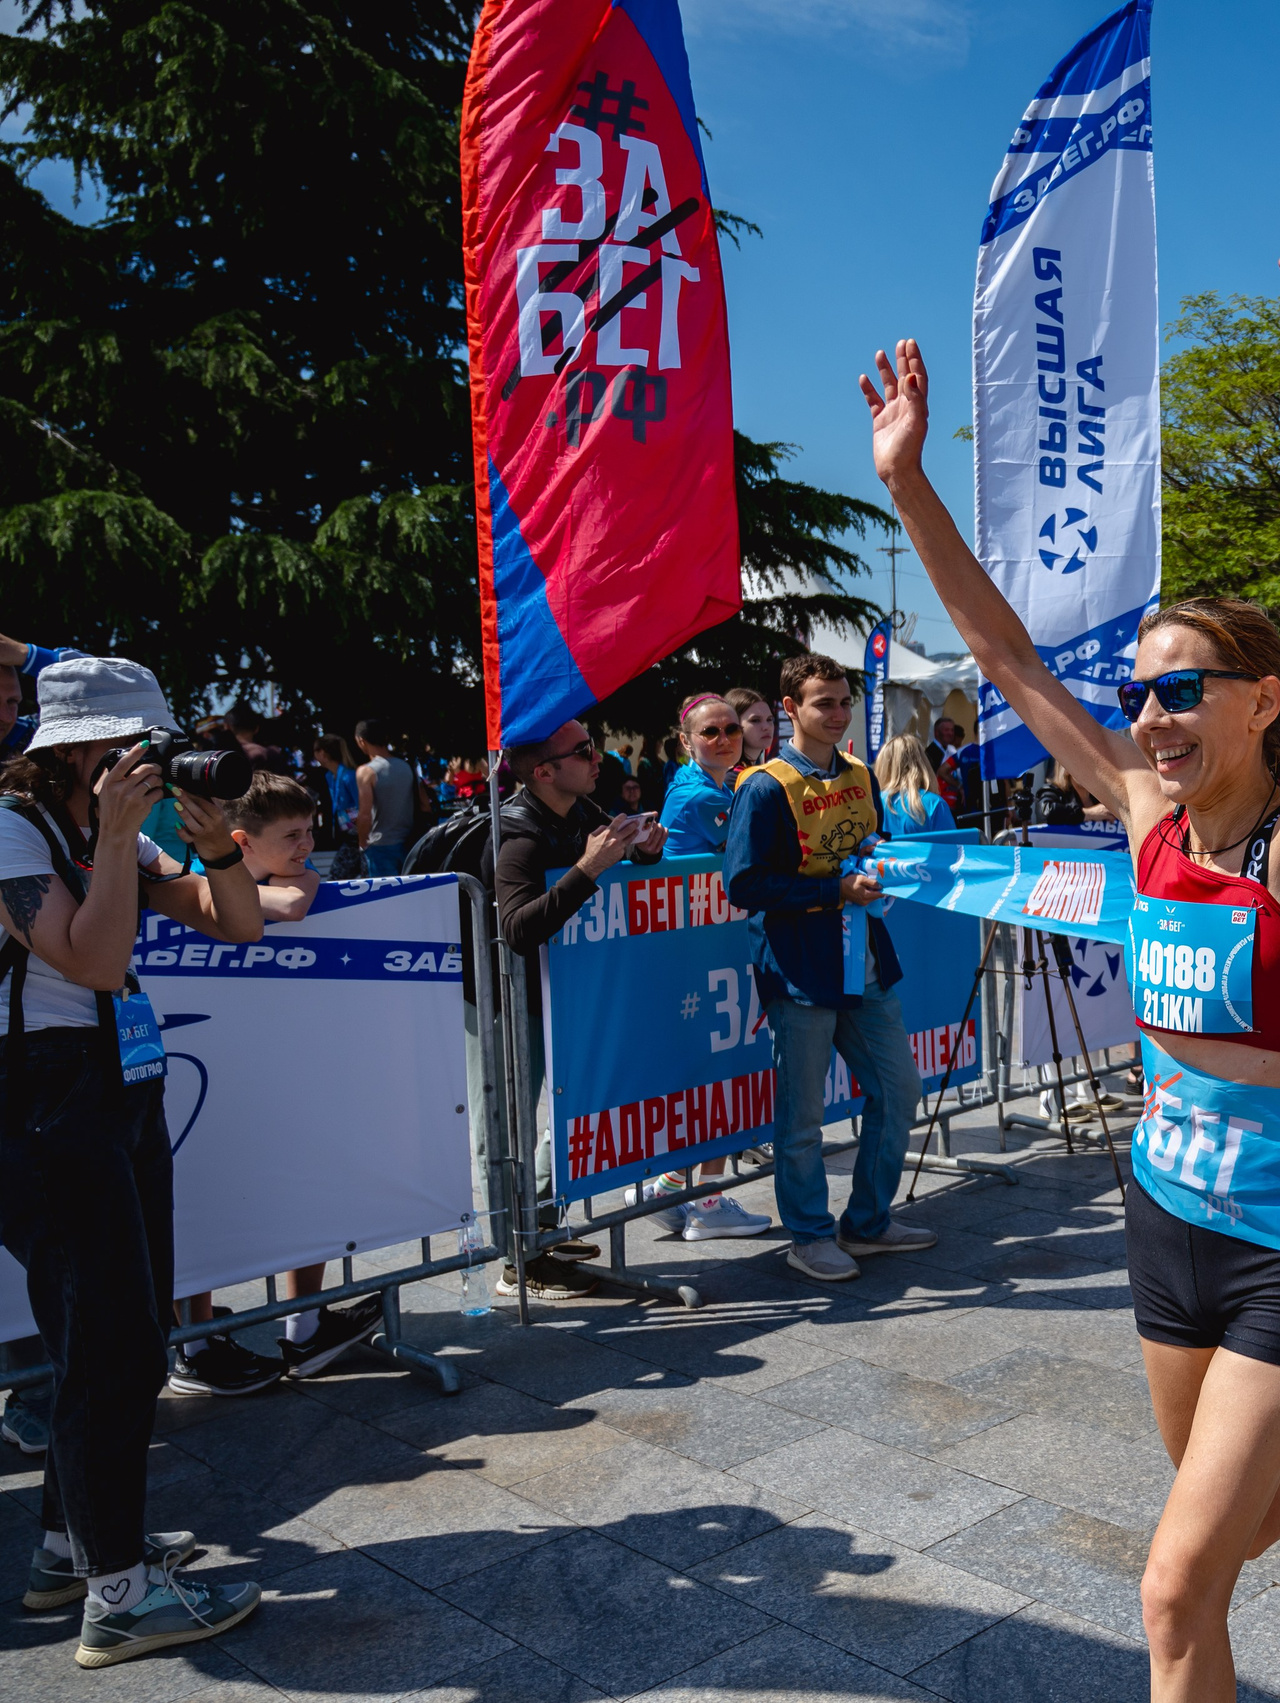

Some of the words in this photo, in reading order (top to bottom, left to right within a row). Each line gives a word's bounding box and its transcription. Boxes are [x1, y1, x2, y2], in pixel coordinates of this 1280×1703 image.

[543, 122, 680, 257] ЗА
[516, 242, 700, 377] БЕГ
[1032, 246, 1067, 489] ВЫСШАЯ
[1076, 355, 1106, 495] ЛИГА
[1080, 820, 1127, 835] ЗАБЕ
[1024, 860, 1107, 926] ФИНИШ
[1138, 938, 1216, 992] 40188
[123, 1061, 163, 1083] ФОТОГРАФ
[1140, 1085, 1264, 1199] БЕГ
